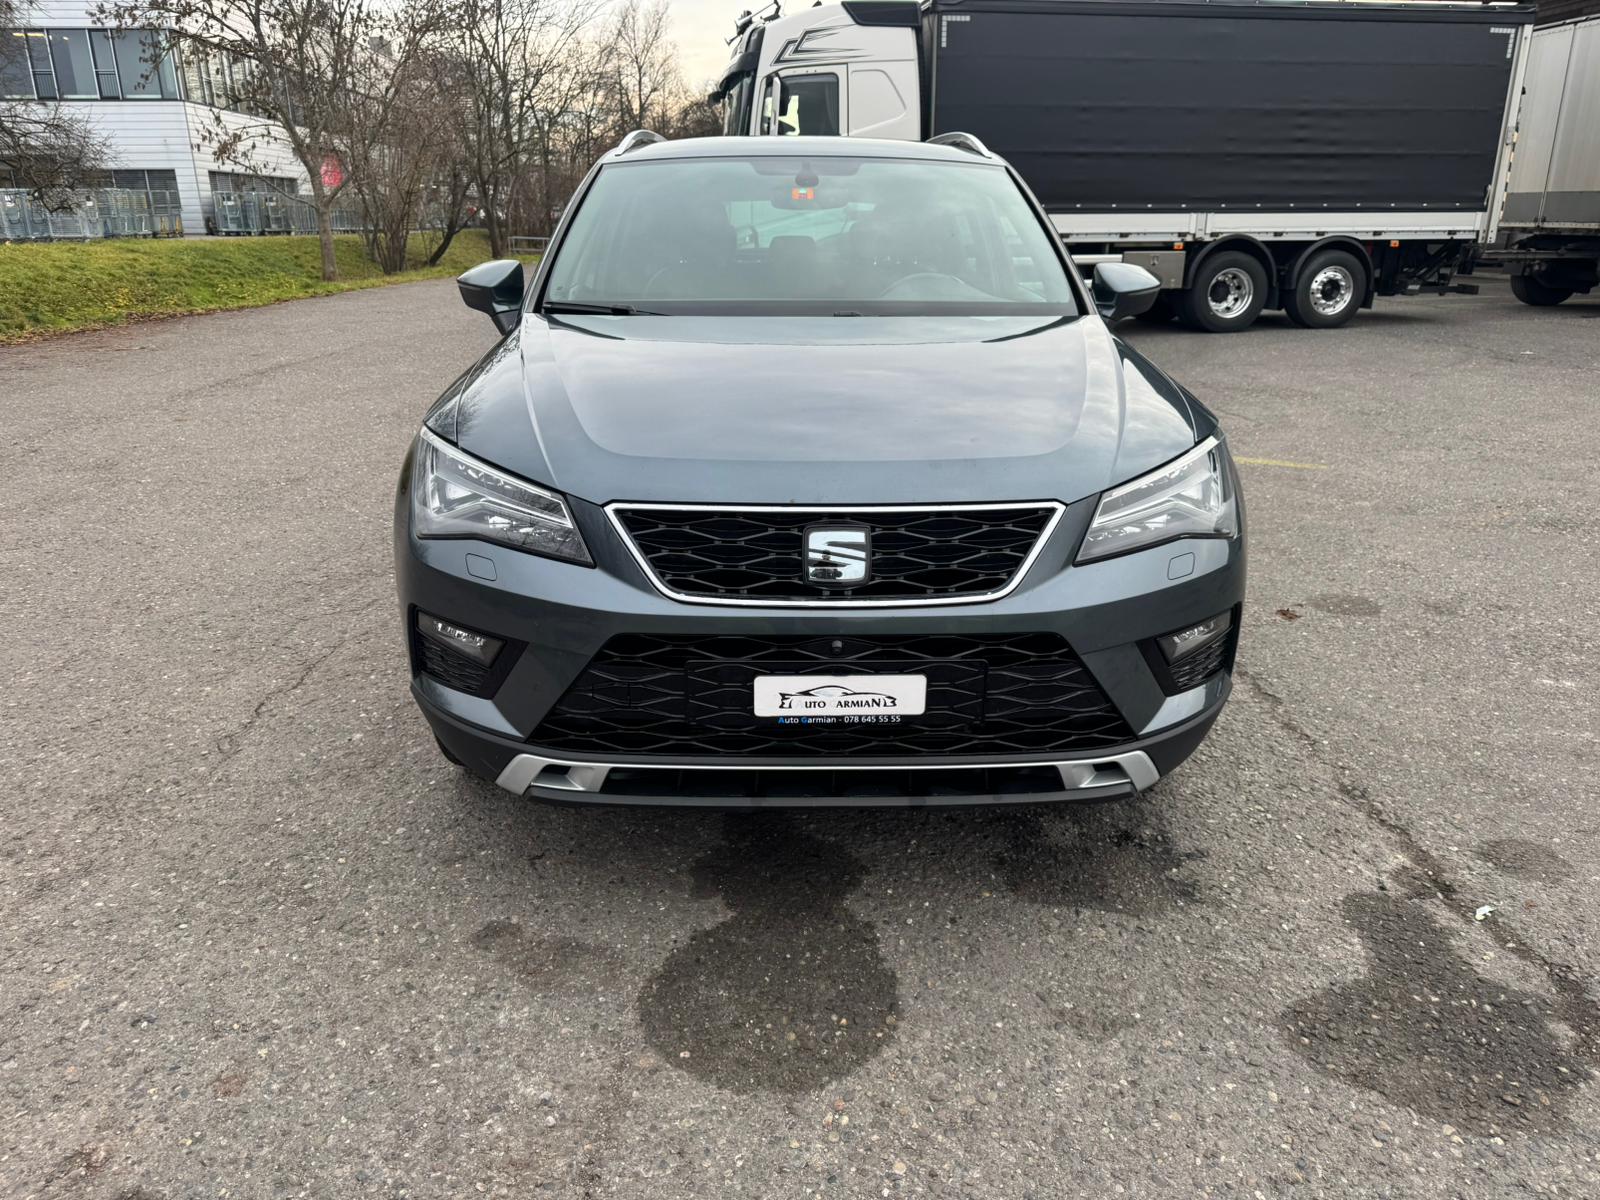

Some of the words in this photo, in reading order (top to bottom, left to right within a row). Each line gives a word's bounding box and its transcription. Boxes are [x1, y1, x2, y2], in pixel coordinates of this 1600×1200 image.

[778, 716, 799, 724] Auto
[800, 716, 837, 724] Garmian
[844, 715, 860, 723] 078
[861, 715, 877, 723] 645
[879, 715, 890, 723] 55
[891, 715, 902, 723] 55
